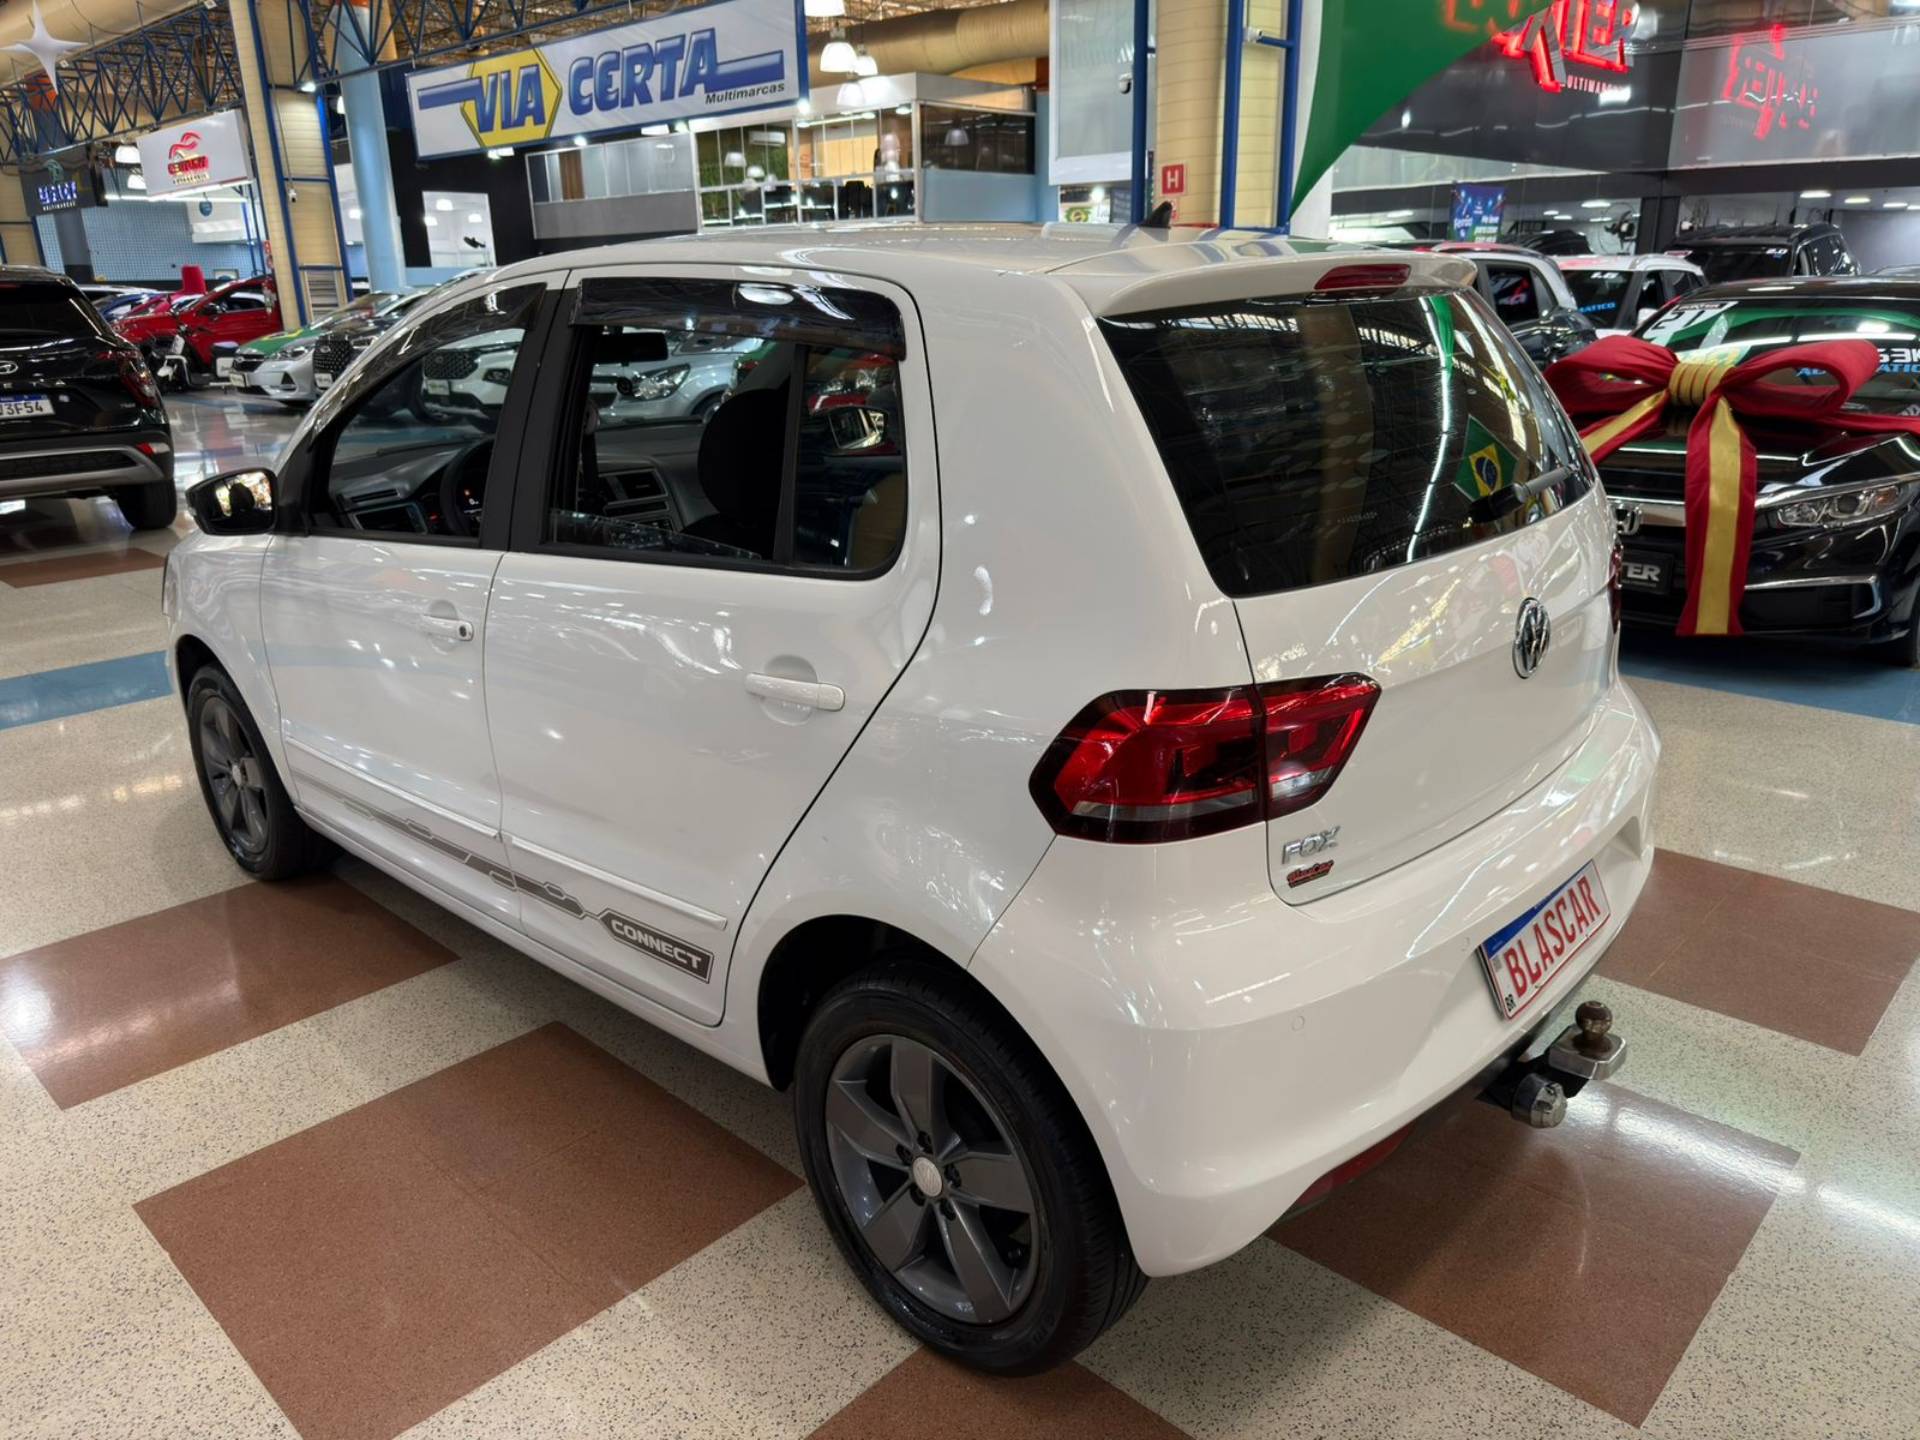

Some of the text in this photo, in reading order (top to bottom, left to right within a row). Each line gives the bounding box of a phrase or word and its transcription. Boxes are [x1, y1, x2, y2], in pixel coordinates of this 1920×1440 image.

[476, 27, 720, 133] VIA CERTA
[705, 83, 785, 105] Multimarcas
[1167, 169, 1179, 190] H
[1281, 825, 1341, 865] FOX
[610, 919, 702, 969] CONNECT
[1503, 875, 1602, 998] BLASCAR
